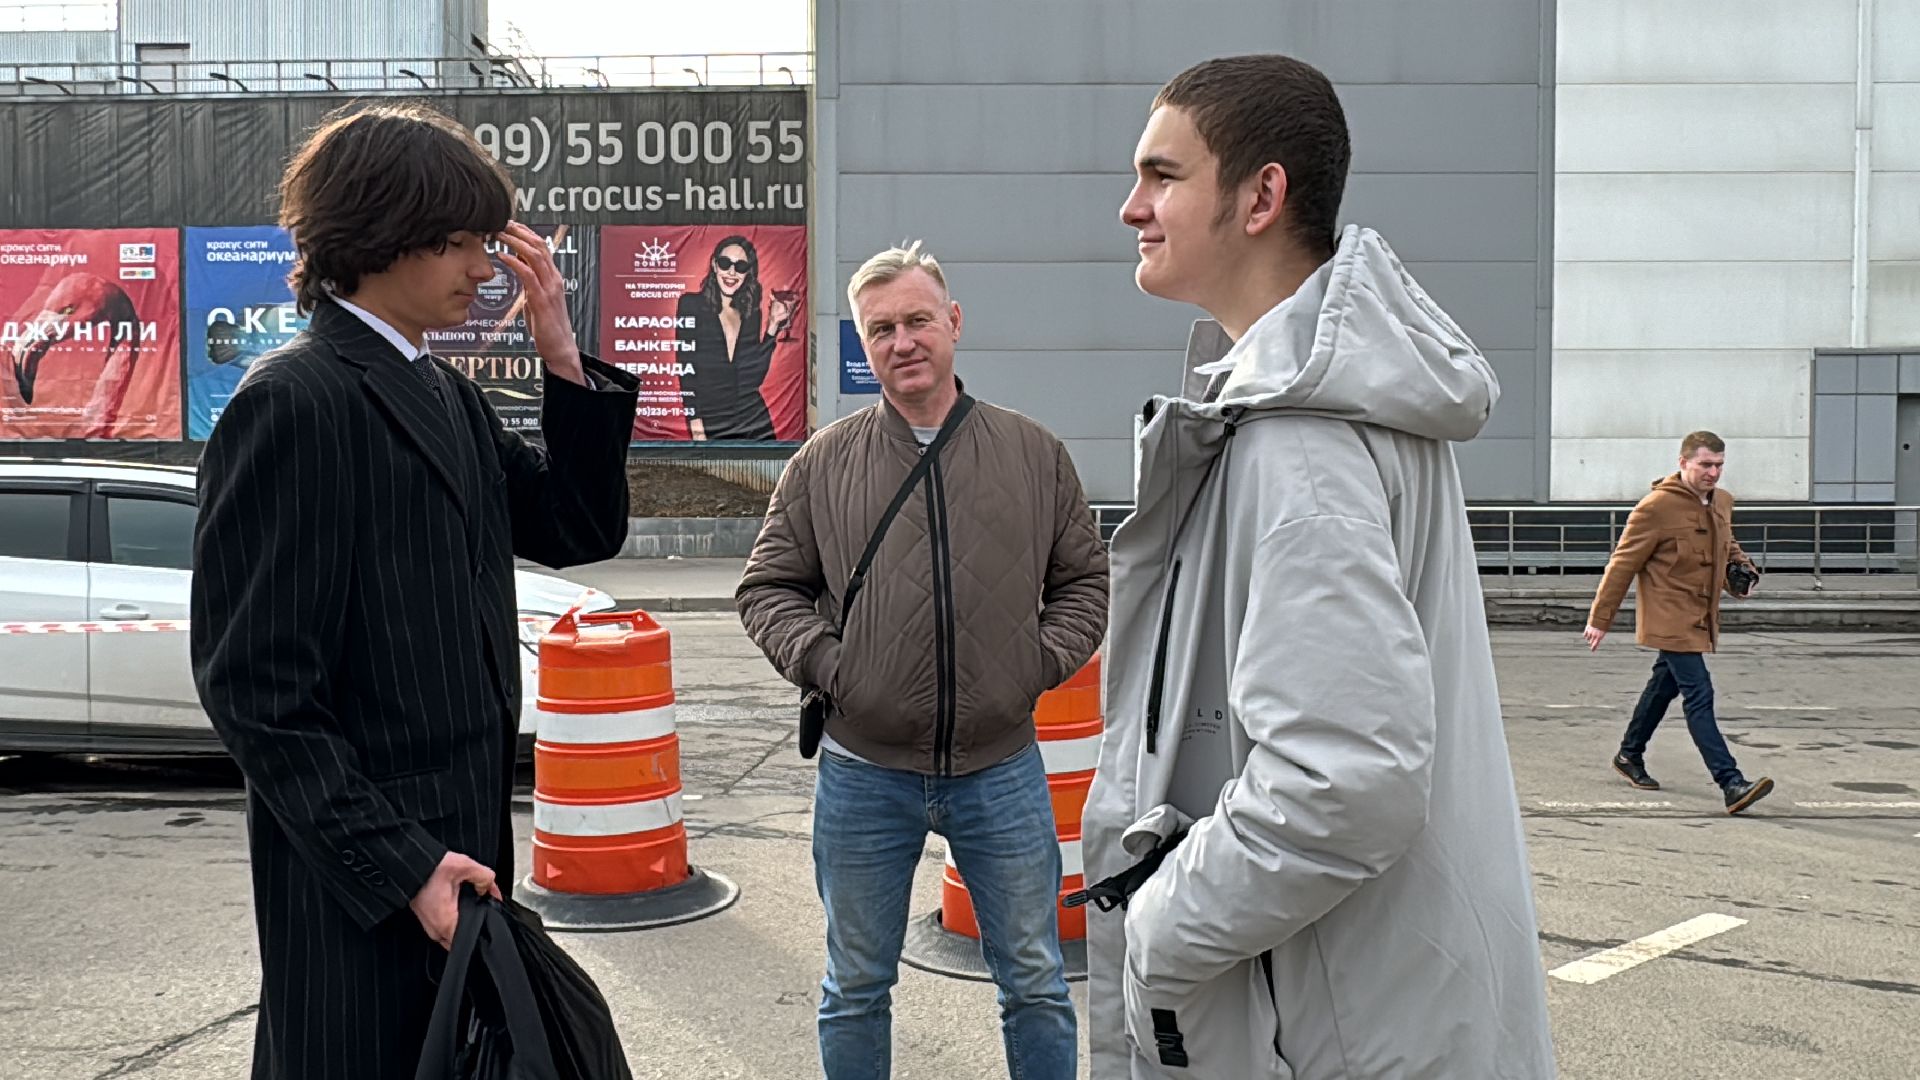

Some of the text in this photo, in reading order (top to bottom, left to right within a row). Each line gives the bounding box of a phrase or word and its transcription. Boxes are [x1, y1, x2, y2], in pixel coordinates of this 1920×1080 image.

[567, 121, 623, 165] 55
[637, 120, 732, 165] 000
[747, 120, 804, 164] 55
[0, 254, 88, 267] океанариум
[206, 251, 295, 264] океанариум
[614, 316, 696, 328] КАРАОКЕ
[2, 321, 157, 341] ДЖУНГЛИ
[480, 332, 524, 345] театра
[614, 340, 696, 352] БАНКЕТЫ
